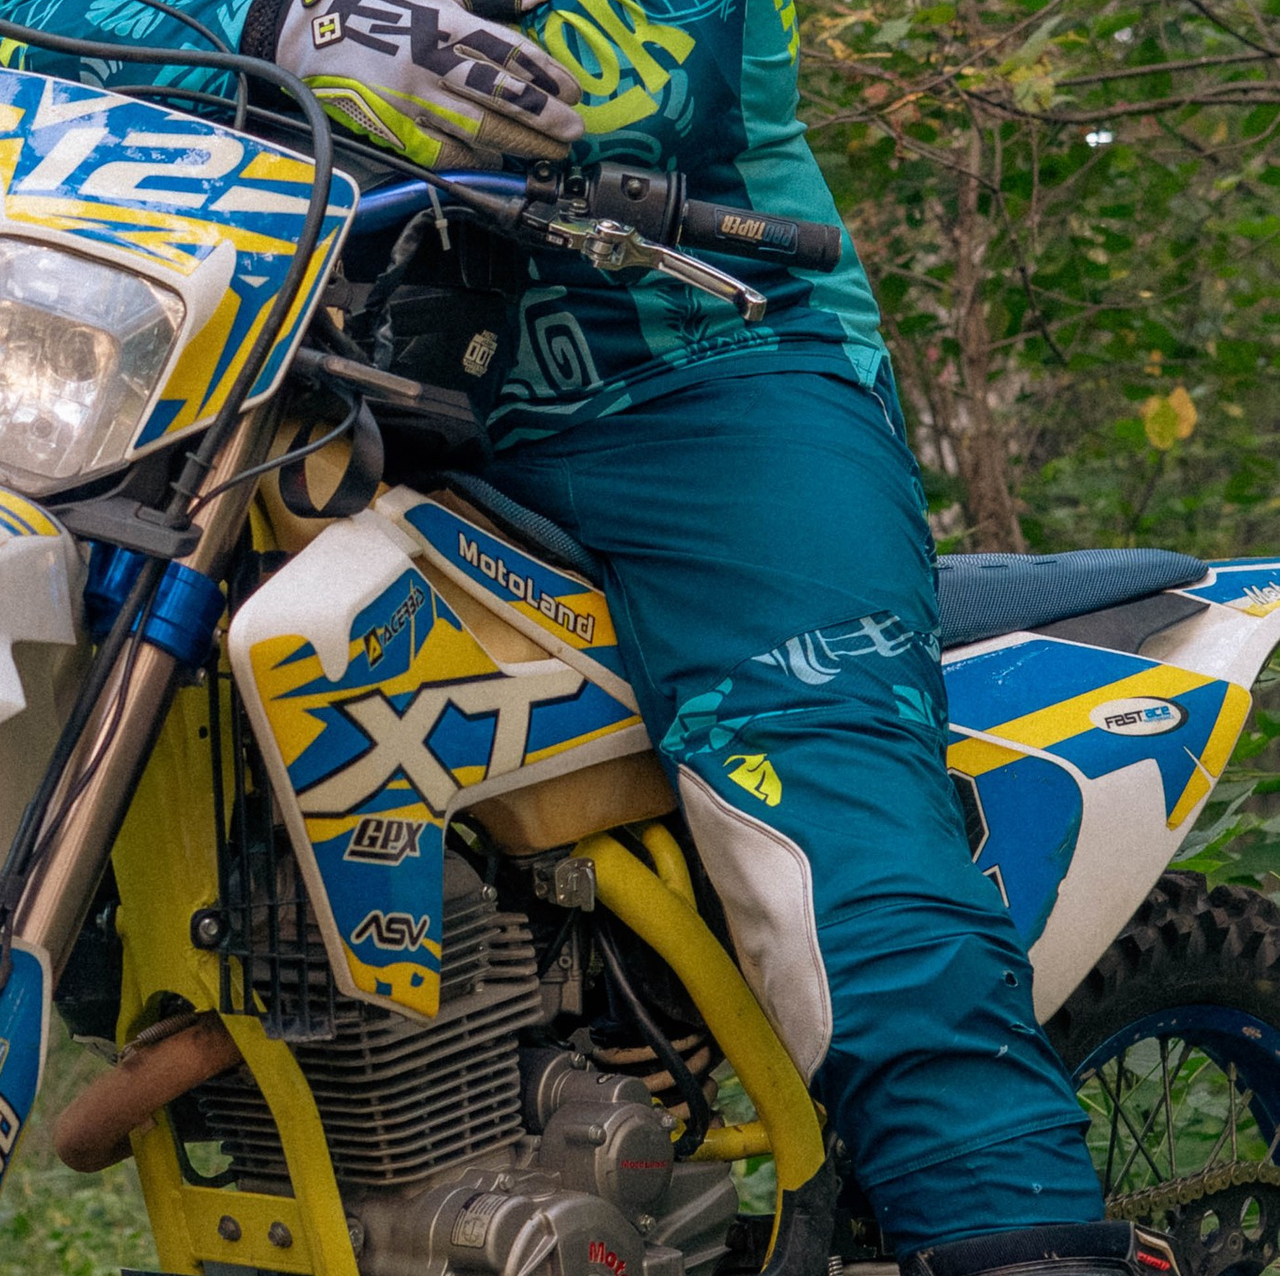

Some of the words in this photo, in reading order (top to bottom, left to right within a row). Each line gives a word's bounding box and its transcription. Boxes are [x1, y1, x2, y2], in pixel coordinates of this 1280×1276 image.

[458, 530, 596, 645] MotoLand
[297, 672, 589, 819] XT
[345, 817, 426, 864] GPX
[351, 910, 430, 951] ASV
